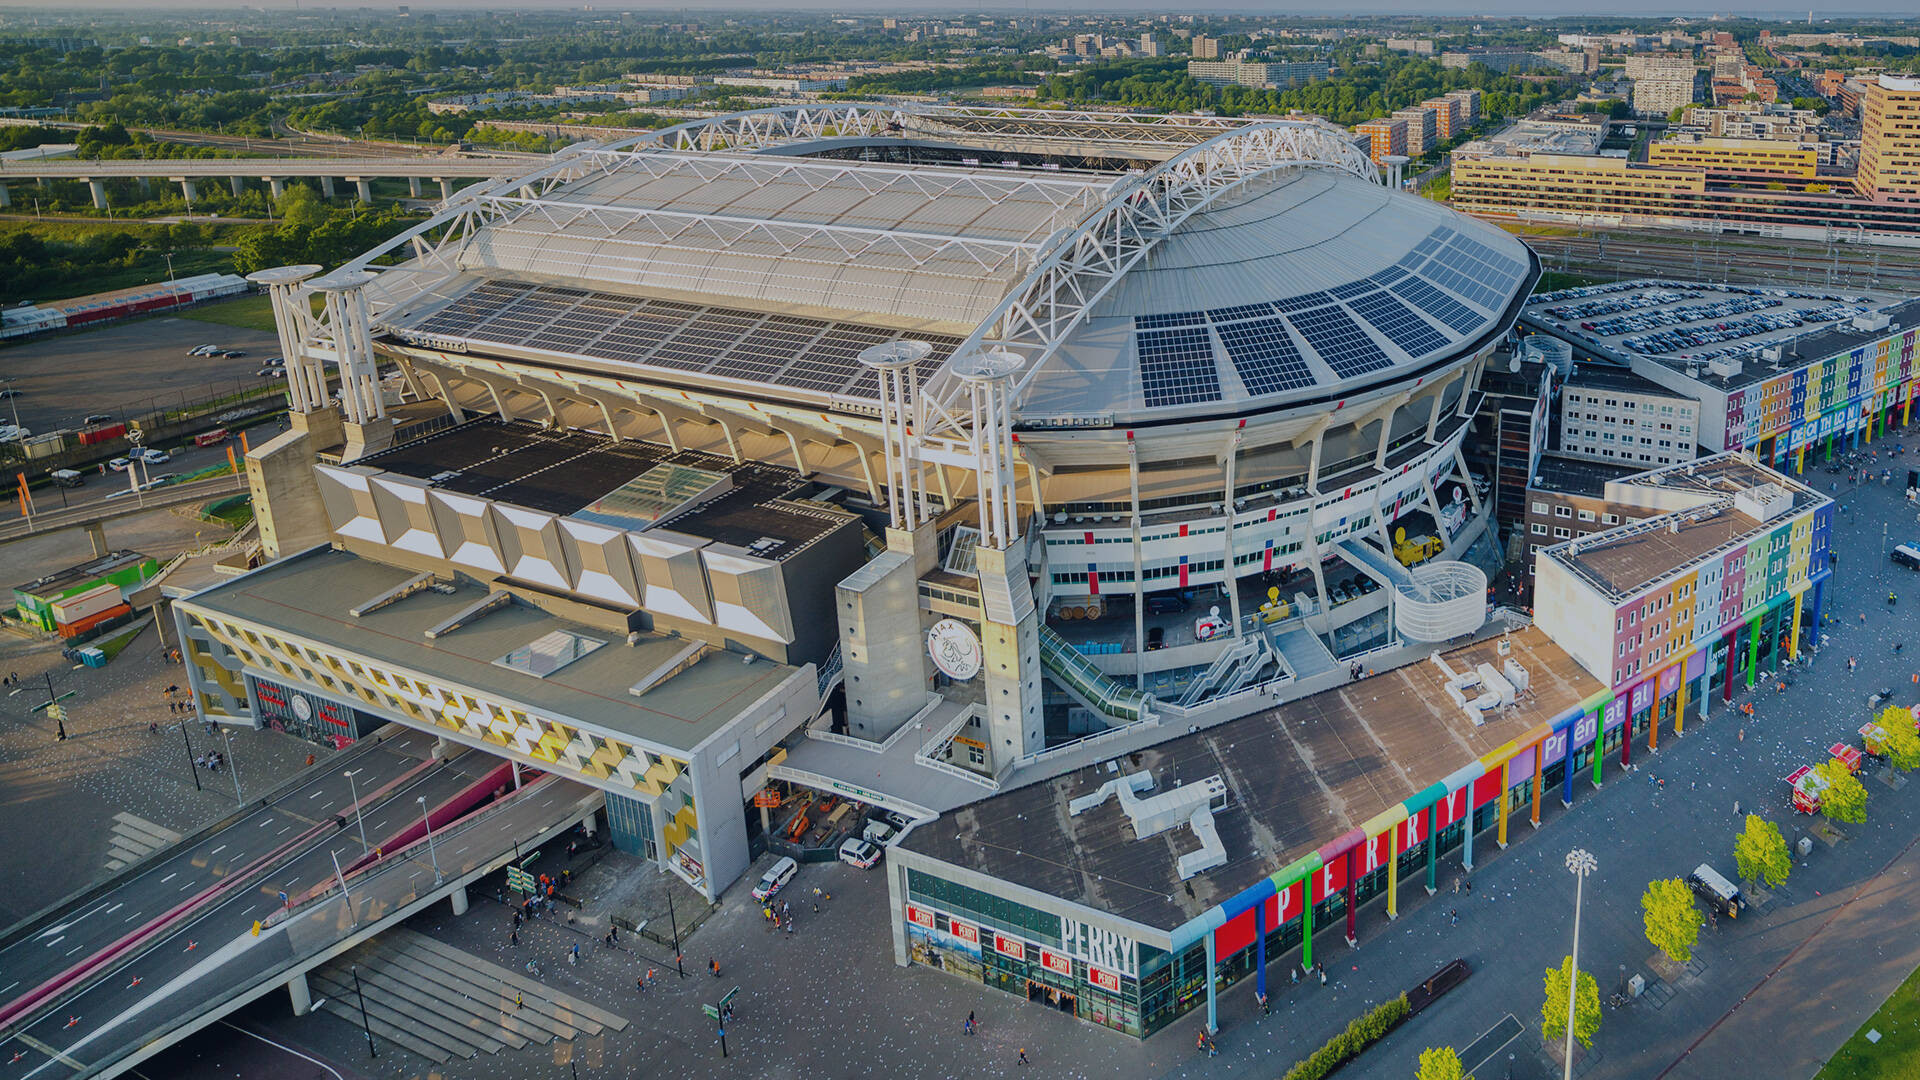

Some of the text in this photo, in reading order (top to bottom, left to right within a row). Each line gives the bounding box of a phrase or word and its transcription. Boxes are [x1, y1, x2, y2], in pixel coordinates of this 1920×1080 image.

[931, 622, 954, 641] AJAX
[1277, 791, 1456, 926] PERRY
[915, 909, 932, 927] PERRY
[959, 924, 976, 942] PERRY
[1003, 940, 1021, 958] PERRY
[1060, 917, 1132, 975] PERRY
[1050, 955, 1068, 974] PERRY
[1098, 972, 1116, 991] PERRY
